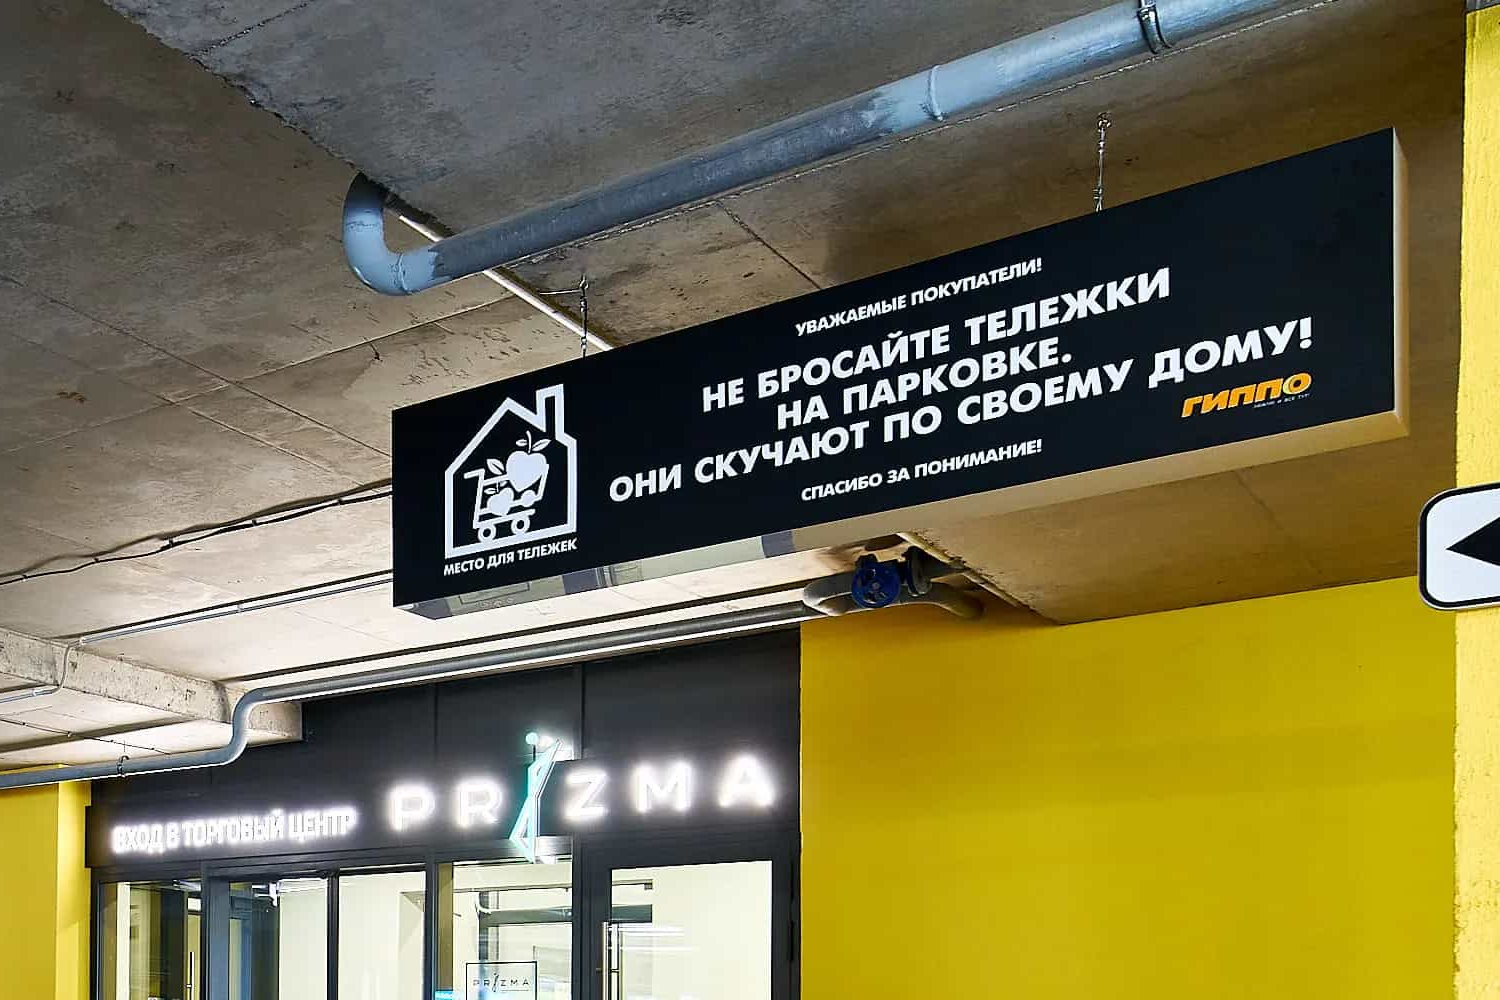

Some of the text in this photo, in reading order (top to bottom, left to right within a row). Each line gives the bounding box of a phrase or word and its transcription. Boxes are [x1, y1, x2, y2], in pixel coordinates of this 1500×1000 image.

[795, 257, 1043, 337] УВАЖАЕМЫЕ ПОКУПАТЕЛИ!
[702, 267, 1171, 413] НЕ БРОСАЙТЕ ТЕЛЕЖКИ
[608, 316, 1313, 502] ОНИ СКУЧАЮТ ПО СВОЕМУ ДОМУ!
[776, 336, 1072, 431] НА ПАРКОВКЕ.
[1180, 372, 1313, 419] ГИППО
[800, 438, 1043, 502] СПАСИБО ЗА ПОНИМАНИЕ!
[443, 537, 578, 577] МЕСТО ДЛЯ ТЕЛЕЖЕК
[112, 806, 357, 855] ВХОД В ТОРГОВЫЙ ЦЕНТР
